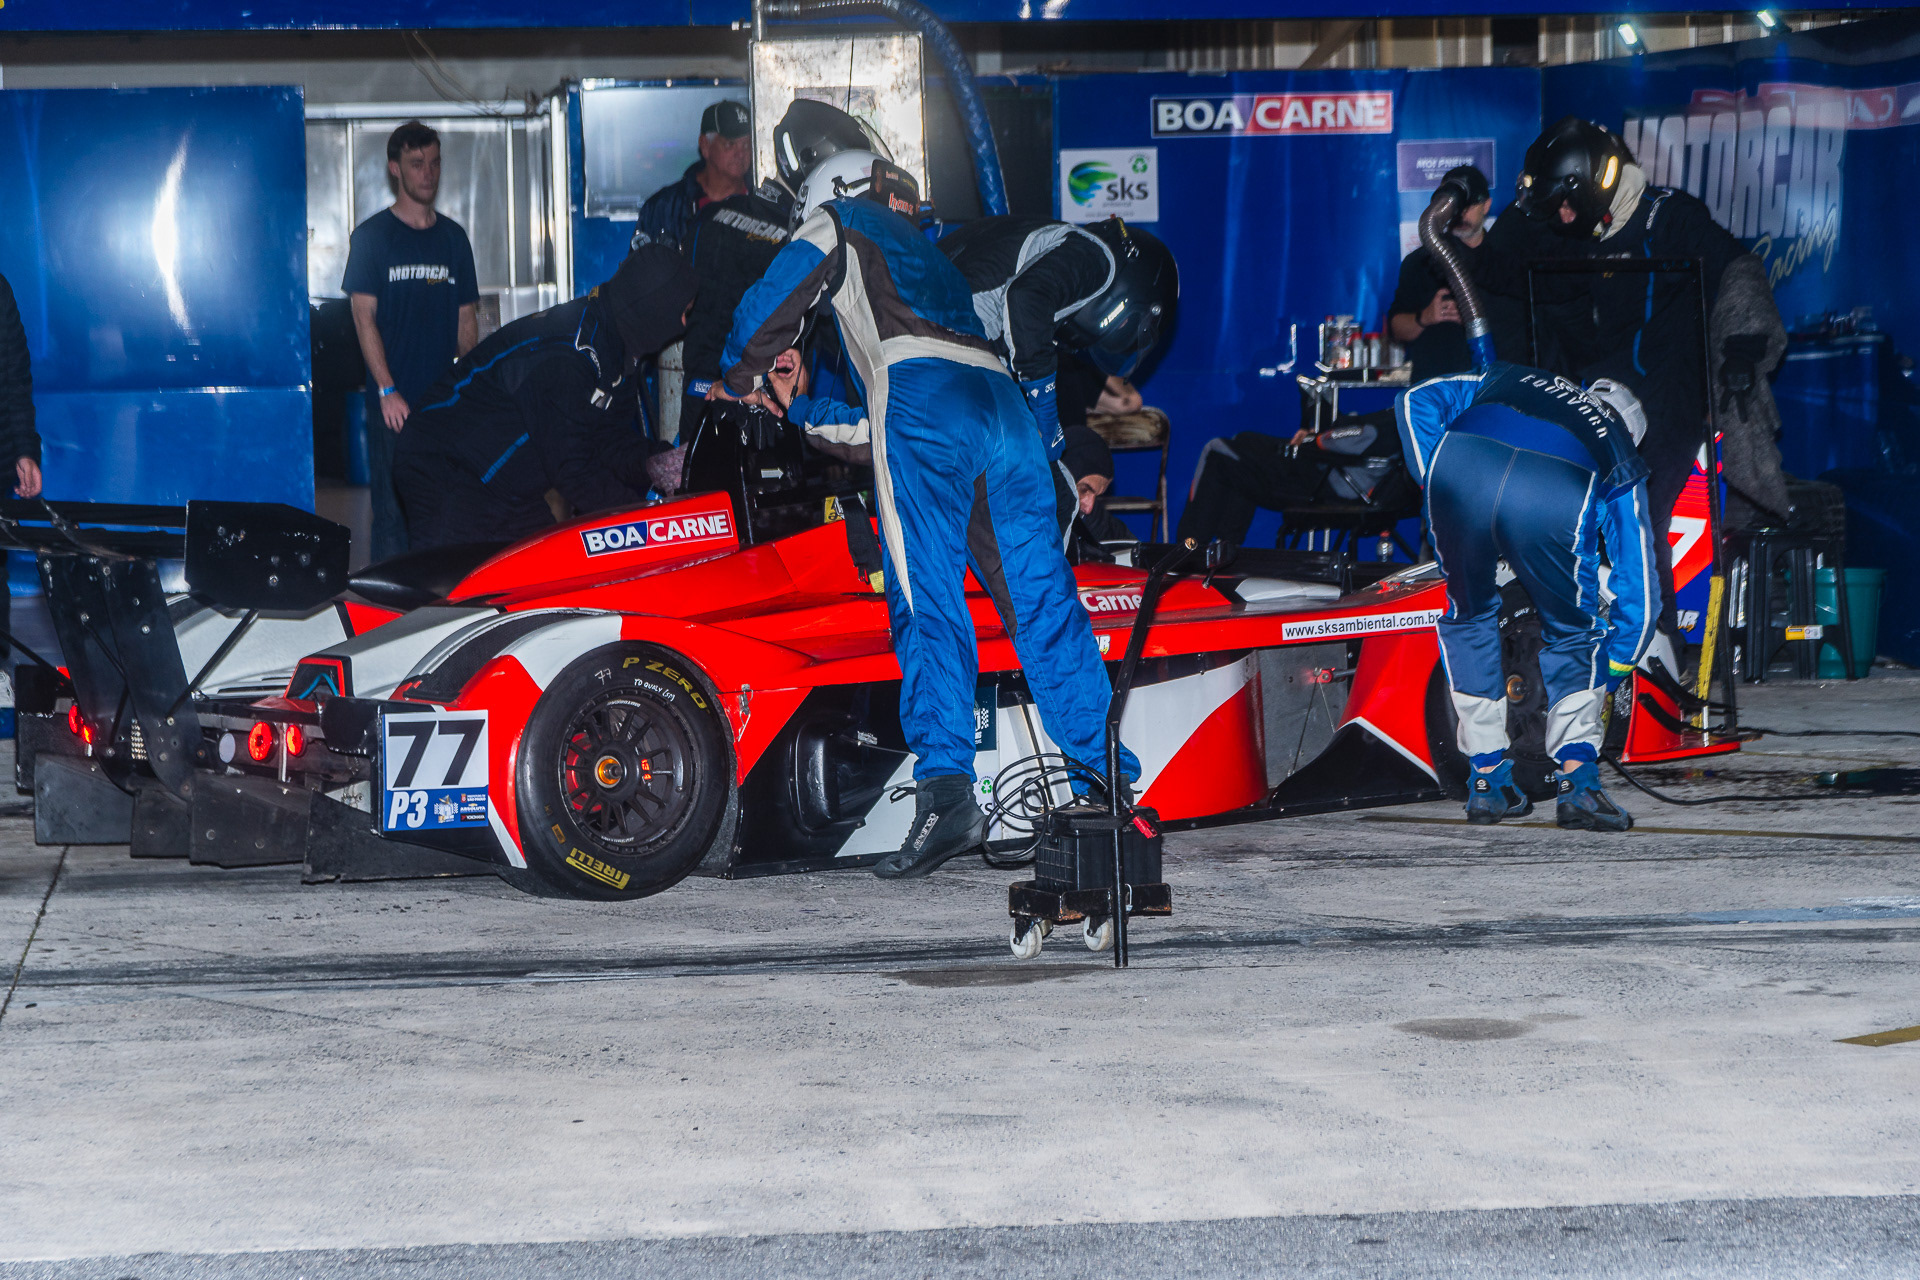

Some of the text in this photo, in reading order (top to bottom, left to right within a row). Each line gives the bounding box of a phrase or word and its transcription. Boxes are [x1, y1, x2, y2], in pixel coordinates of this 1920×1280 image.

[1157, 97, 1387, 131] BOA CARNE
[1106, 176, 1149, 201] sks
[1624, 102, 1846, 239] MOTORCAR
[713, 207, 788, 243] MOTORCAR
[585, 513, 729, 553] BOA CARNE
[1080, 592, 1143, 612] Carne
[1285, 612, 1441, 638] www.sksambiental.com.br
[622, 657, 708, 709] P ZERO
[388, 719, 486, 788] 77
[388, 790, 428, 829] P3
[566, 846, 631, 890] PIRELLI
